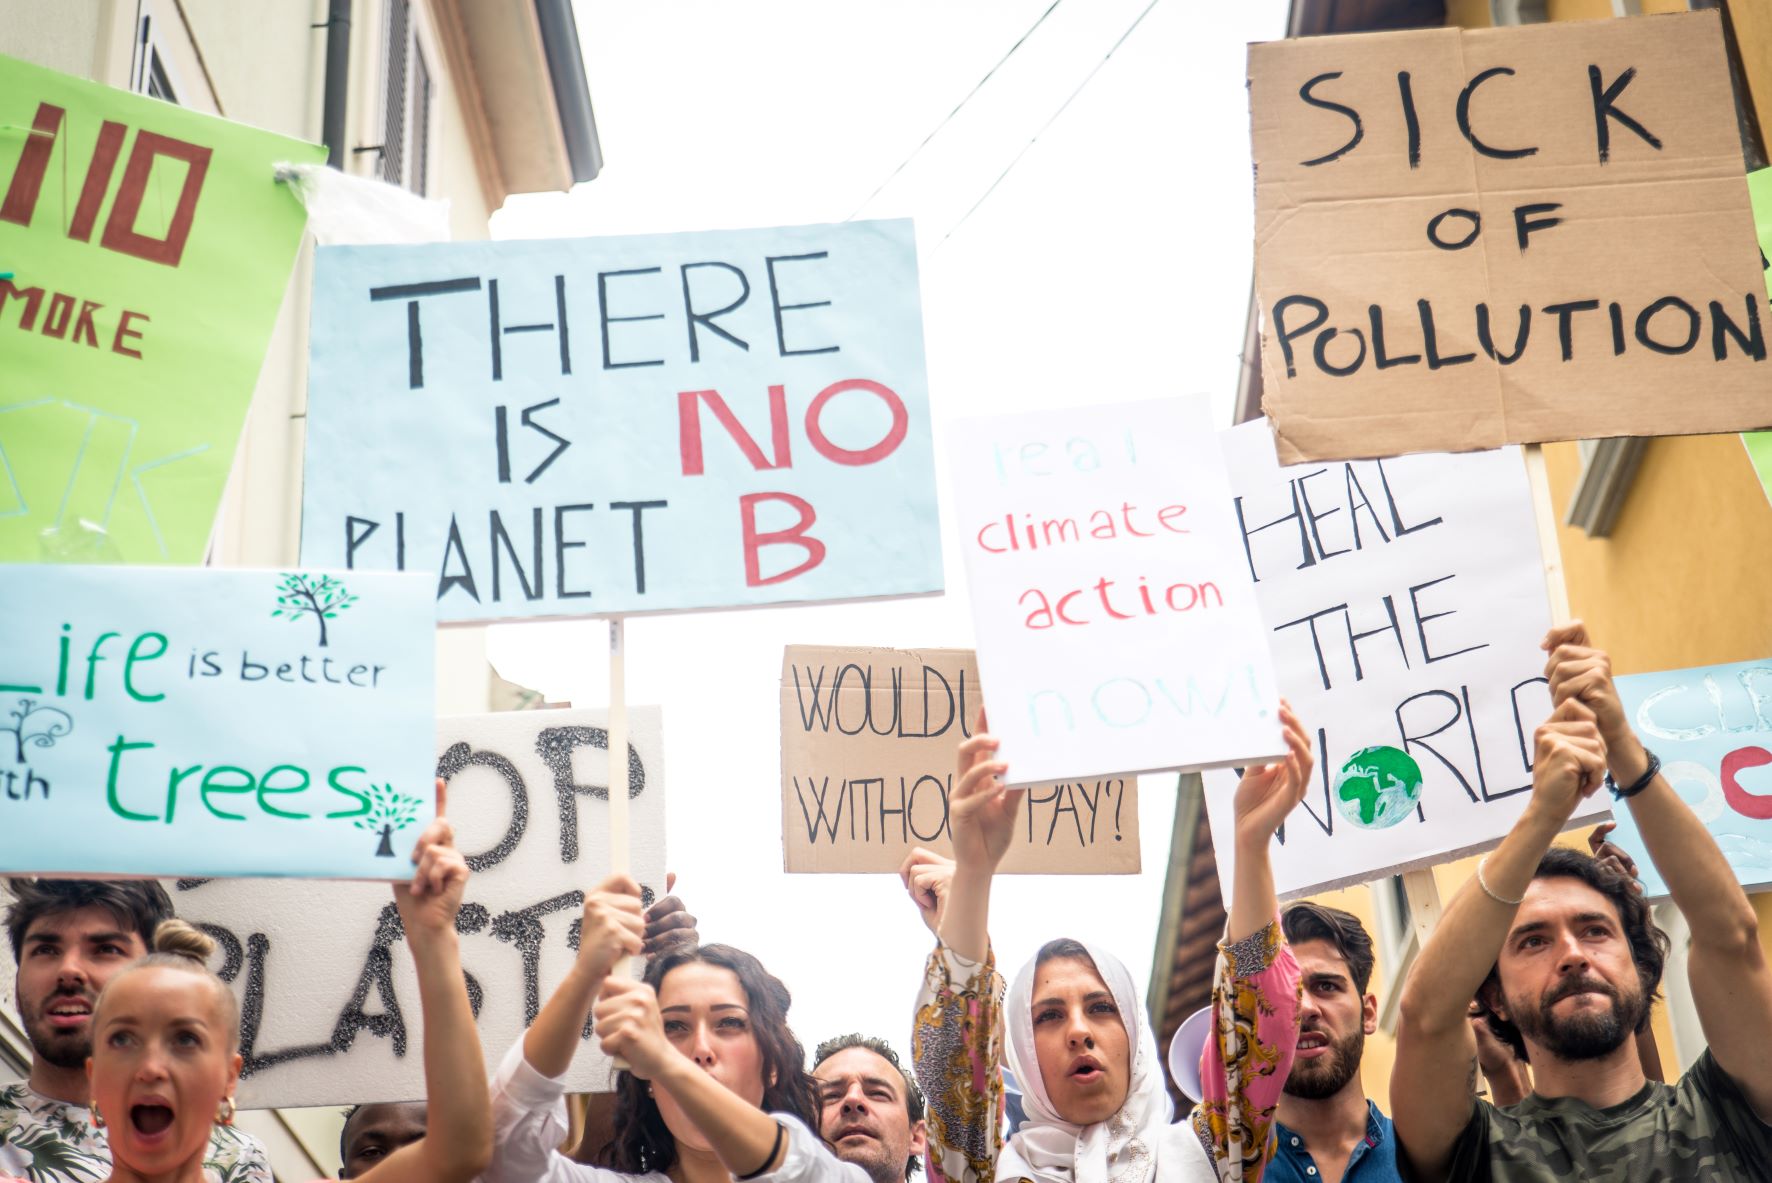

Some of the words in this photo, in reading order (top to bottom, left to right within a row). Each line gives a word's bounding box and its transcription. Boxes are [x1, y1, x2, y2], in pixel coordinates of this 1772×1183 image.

[1299, 65, 1663, 169] SICK
[0, 101, 213, 268] NO
[1426, 203, 1564, 255] OF
[0, 279, 151, 359] MORE
[370, 250, 841, 389] THERE
[1272, 294, 1767, 379] POLLUTION
[496, 397, 572, 484] IS
[677, 378, 908, 476] NO
[992, 424, 1139, 486] real
[739, 492, 826, 587] B
[978, 502, 1192, 553] climate
[1234, 458, 1444, 582] HEAL
[1018, 576, 1225, 629] action
[1273, 573, 1491, 691] THE
[188, 648, 223, 679] is
[241, 651, 388, 689] better
[1026, 664, 1270, 740] now!
[0, 768, 50, 801] th
[106, 734, 373, 824] trees
[436, 725, 646, 873] OP
[793, 773, 953, 845] WITHO
